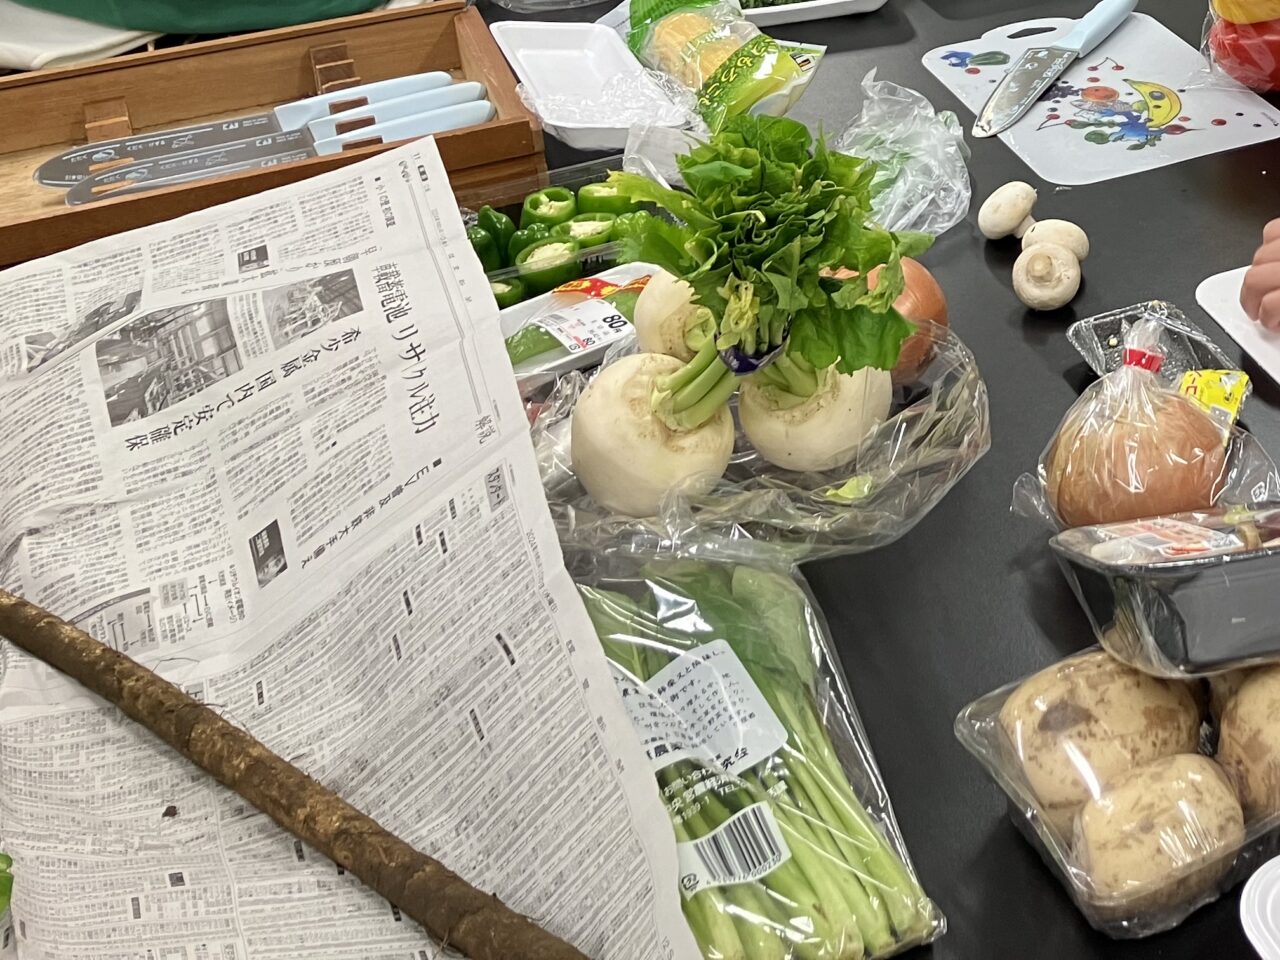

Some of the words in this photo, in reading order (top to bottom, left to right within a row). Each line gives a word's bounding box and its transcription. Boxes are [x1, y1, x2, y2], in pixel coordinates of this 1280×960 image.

[124, 369, 277, 452] 国内で安定確保
